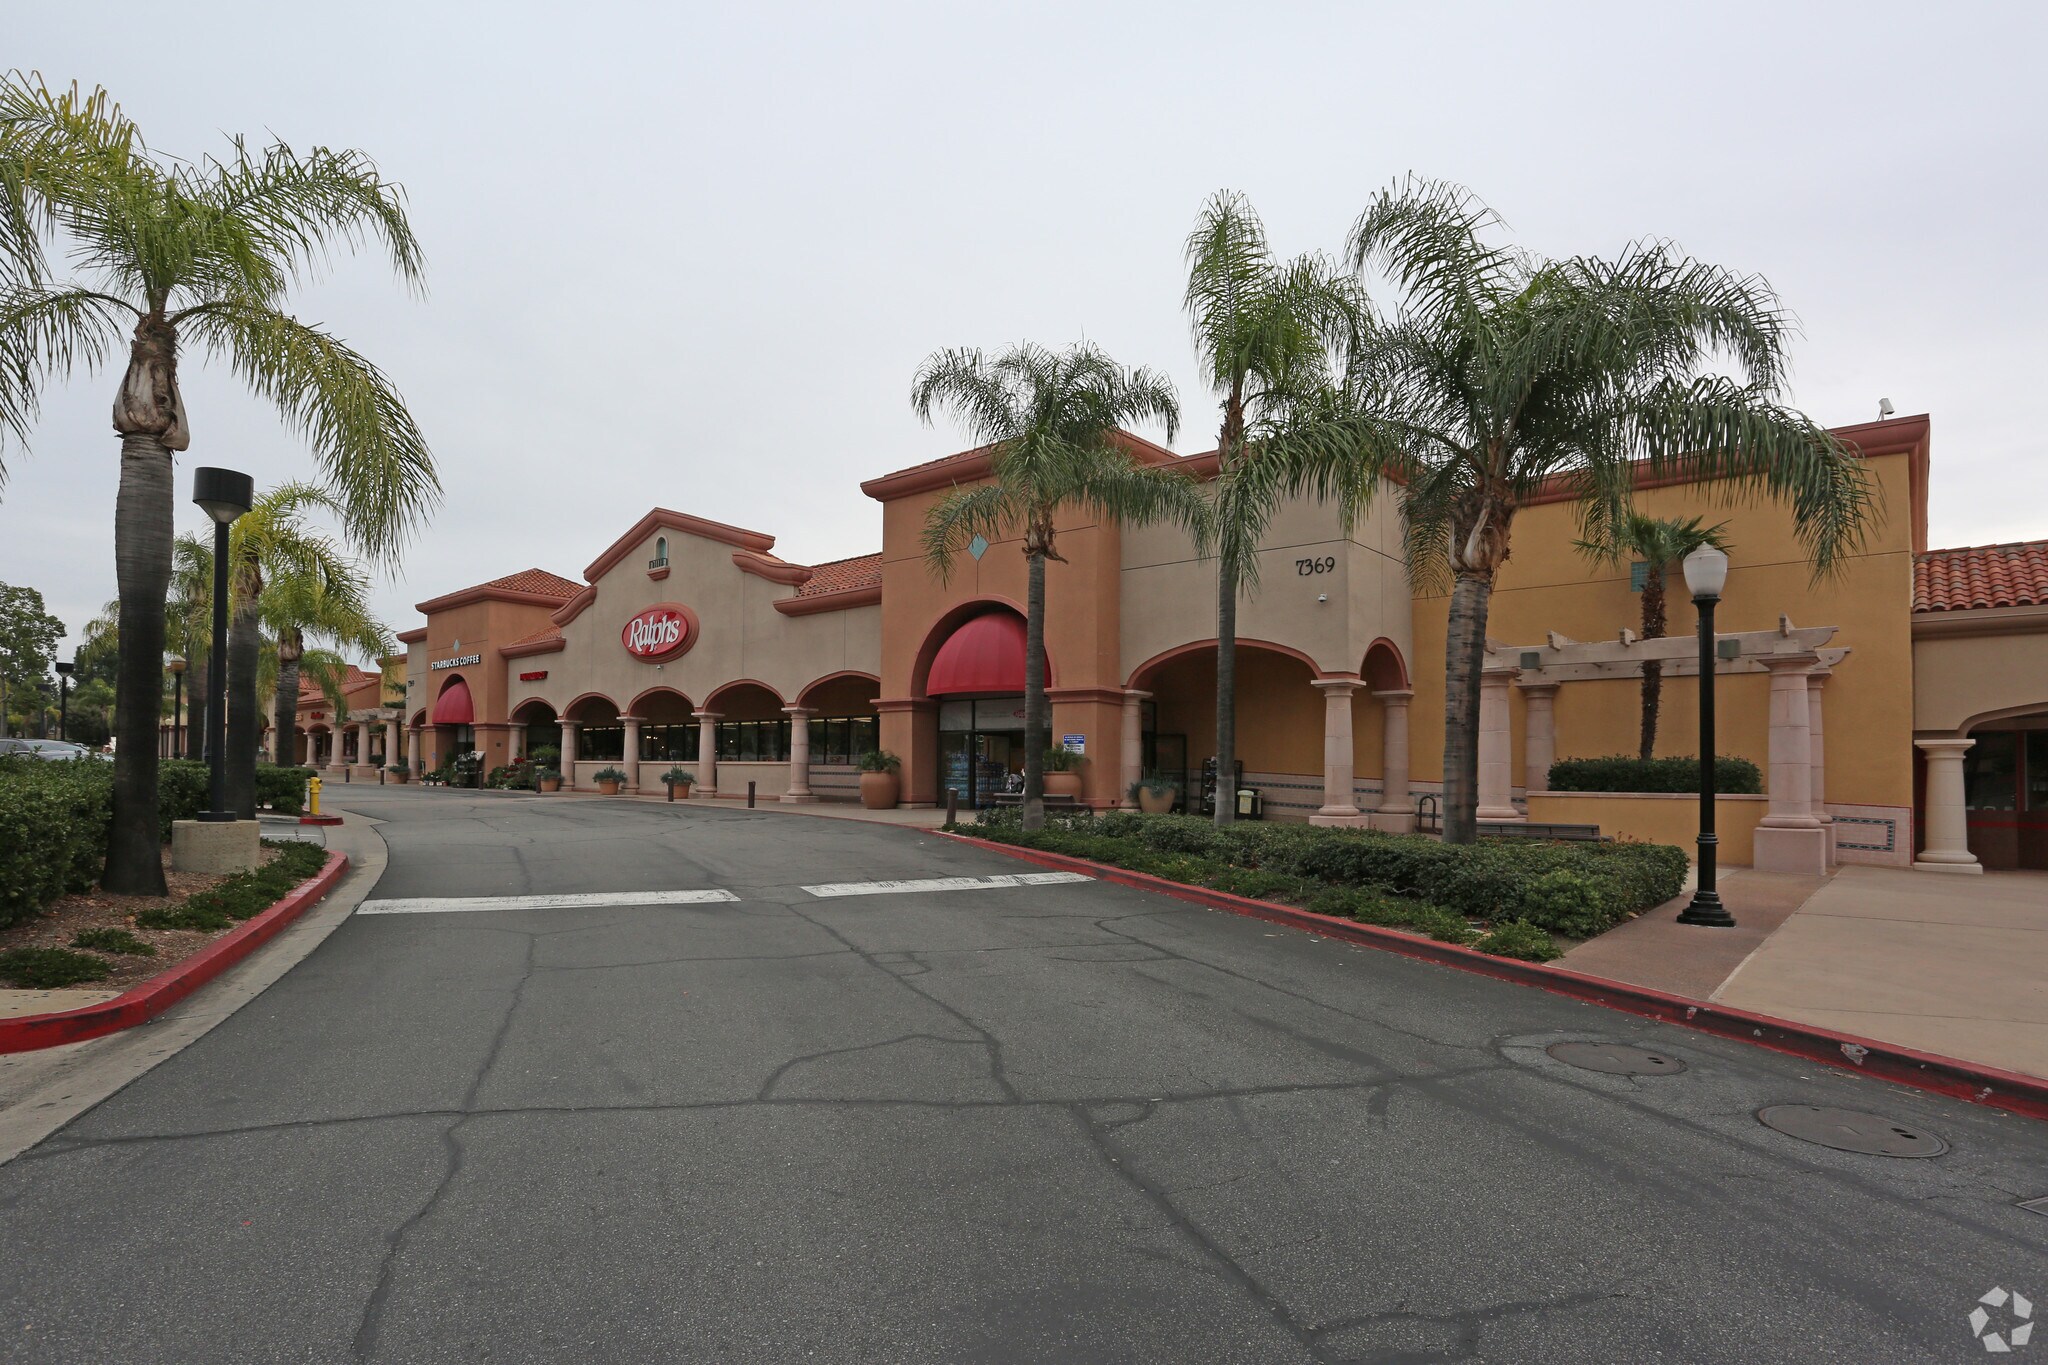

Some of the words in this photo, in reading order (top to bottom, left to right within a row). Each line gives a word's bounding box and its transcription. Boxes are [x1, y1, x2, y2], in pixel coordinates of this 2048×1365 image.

[1295, 556, 1335, 576] 7369
[628, 614, 681, 652] Ralphs
[431, 657, 459, 670] STARBUCKS
[459, 654, 480, 666] COFFEE
